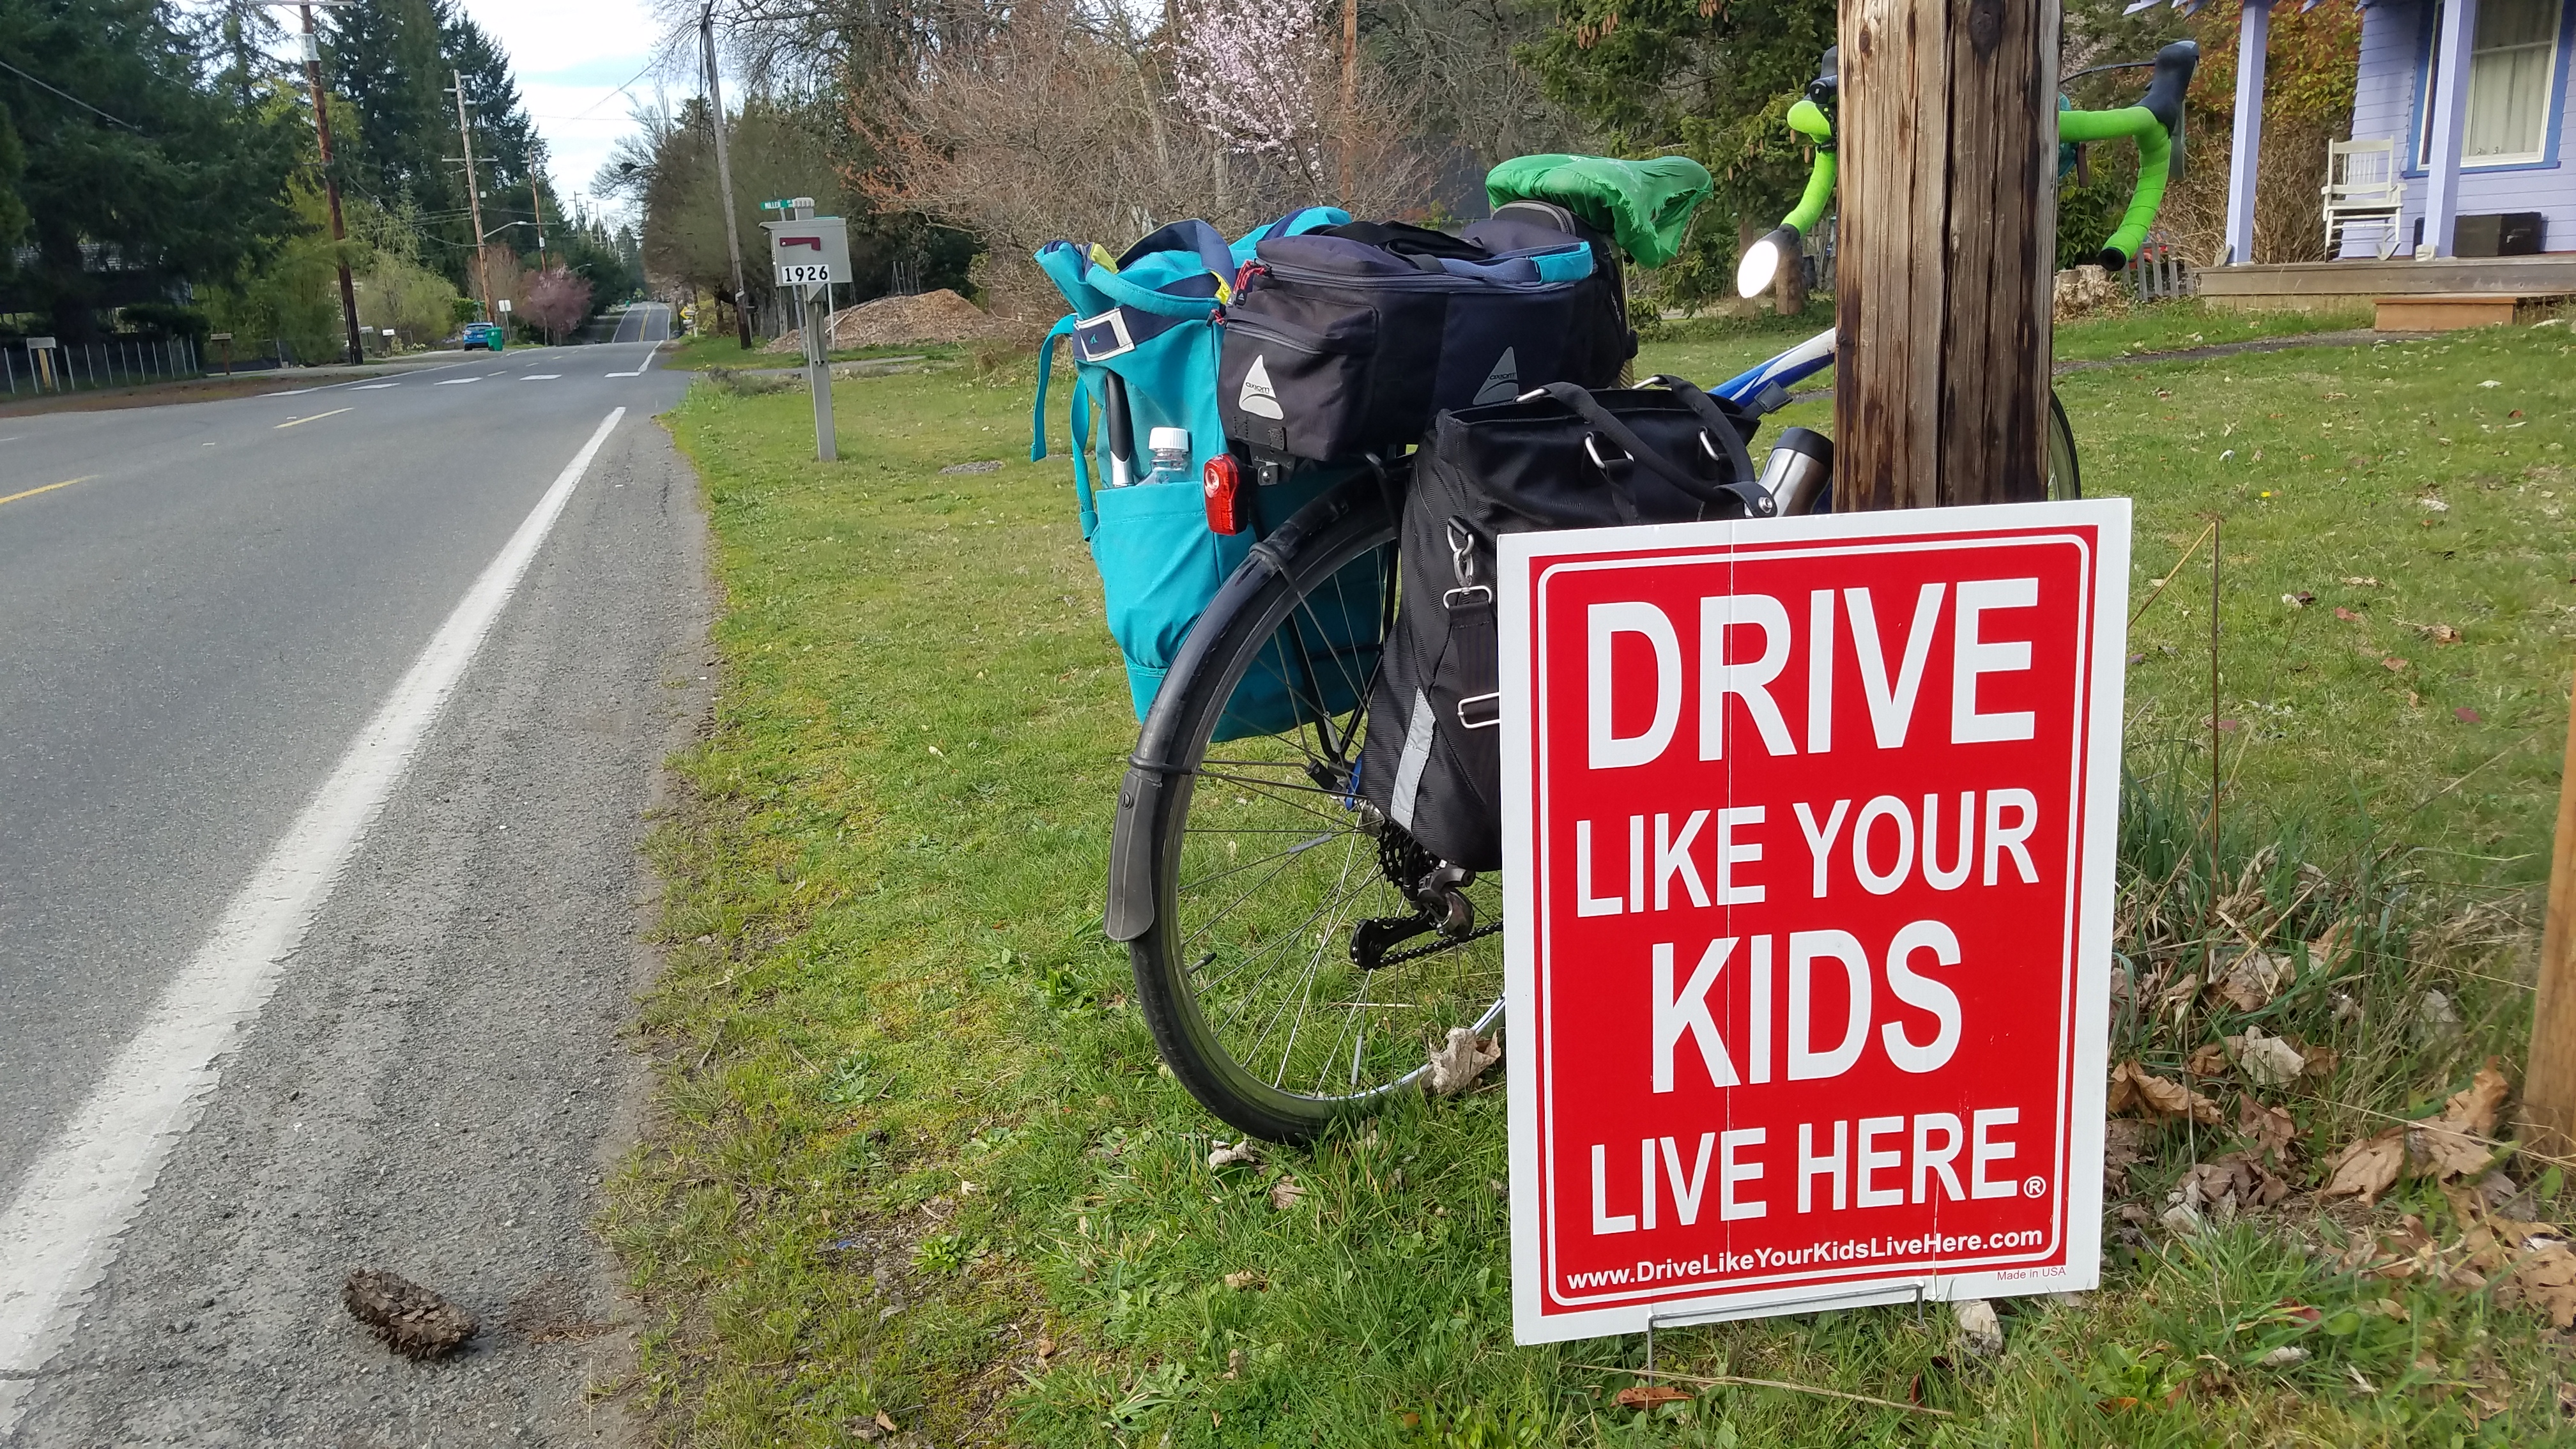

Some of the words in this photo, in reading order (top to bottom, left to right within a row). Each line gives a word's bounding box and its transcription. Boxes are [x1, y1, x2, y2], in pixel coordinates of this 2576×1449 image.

[785, 265, 828, 282] 1926
[1246, 382, 1270, 394] axiom
[1588, 578, 2038, 769] DRIVE
[1577, 804, 1767, 917] LIKE
[1793, 788, 2039, 898] YOUR
[1650, 920, 1961, 1094] KIDS
[1591, 1128, 1767, 1235] LIVE
[1567, 1230, 2042, 1289] www.DriveLikeYourKidsLiveHere.com
[1997, 1270, 2026, 1280] Made
[2029, 1269, 2038, 1278] in
[2042, 1267, 2066, 1276] USA
